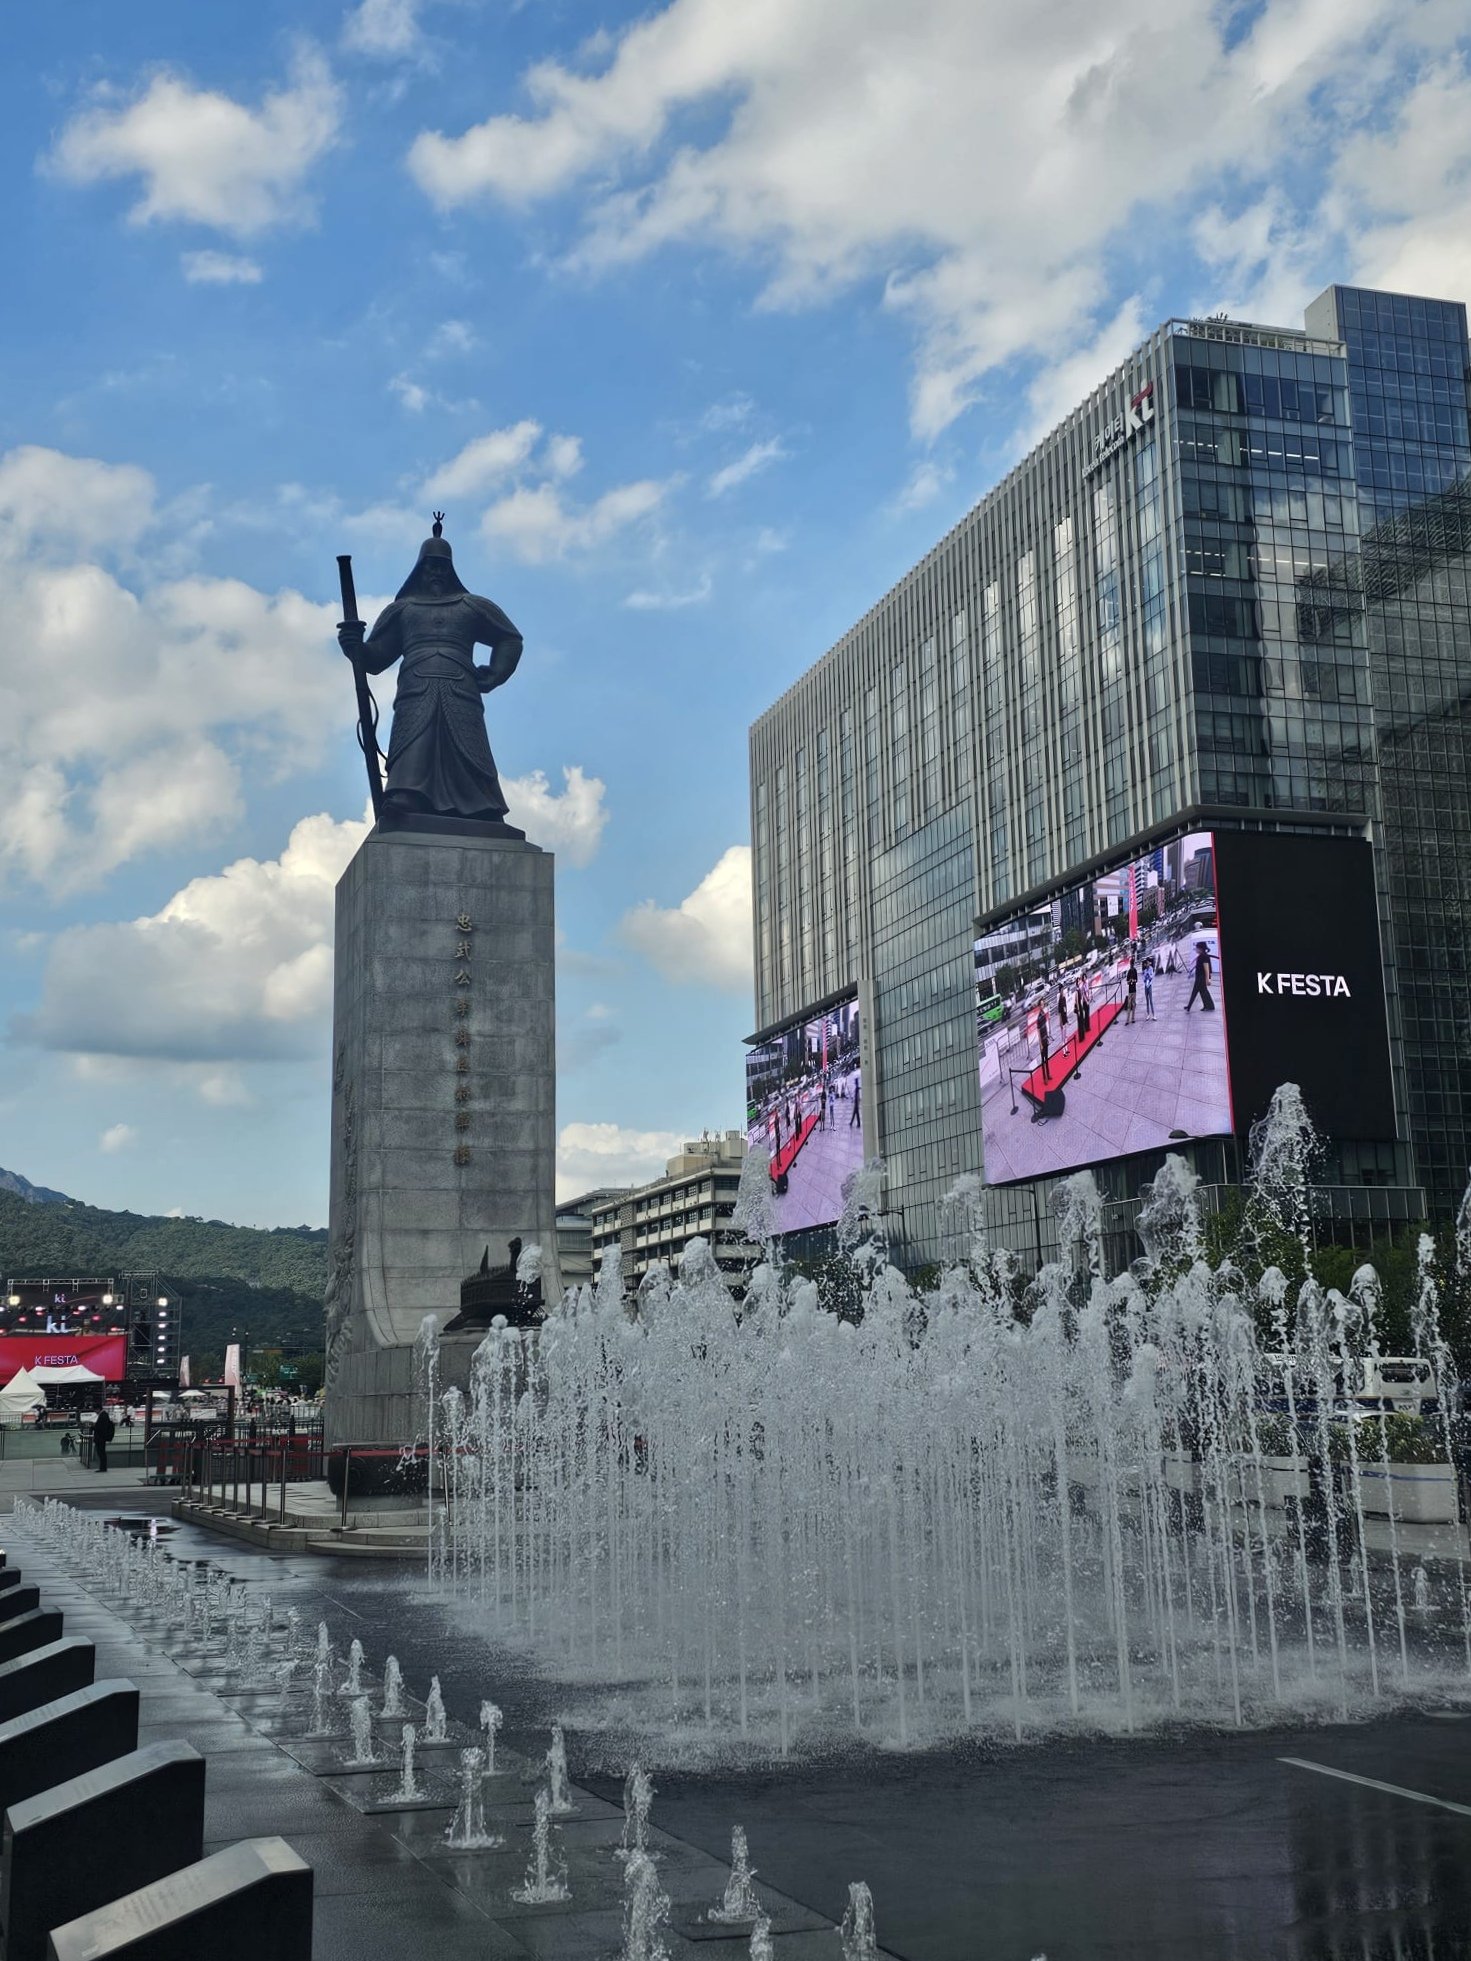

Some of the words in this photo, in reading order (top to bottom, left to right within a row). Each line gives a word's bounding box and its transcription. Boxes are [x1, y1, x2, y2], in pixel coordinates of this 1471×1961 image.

[1257, 972, 1274, 994] K
[1277, 973, 1351, 998] FESTA
[35, 1356, 42, 1365] K
[44, 1355, 78, 1365] FESTA
